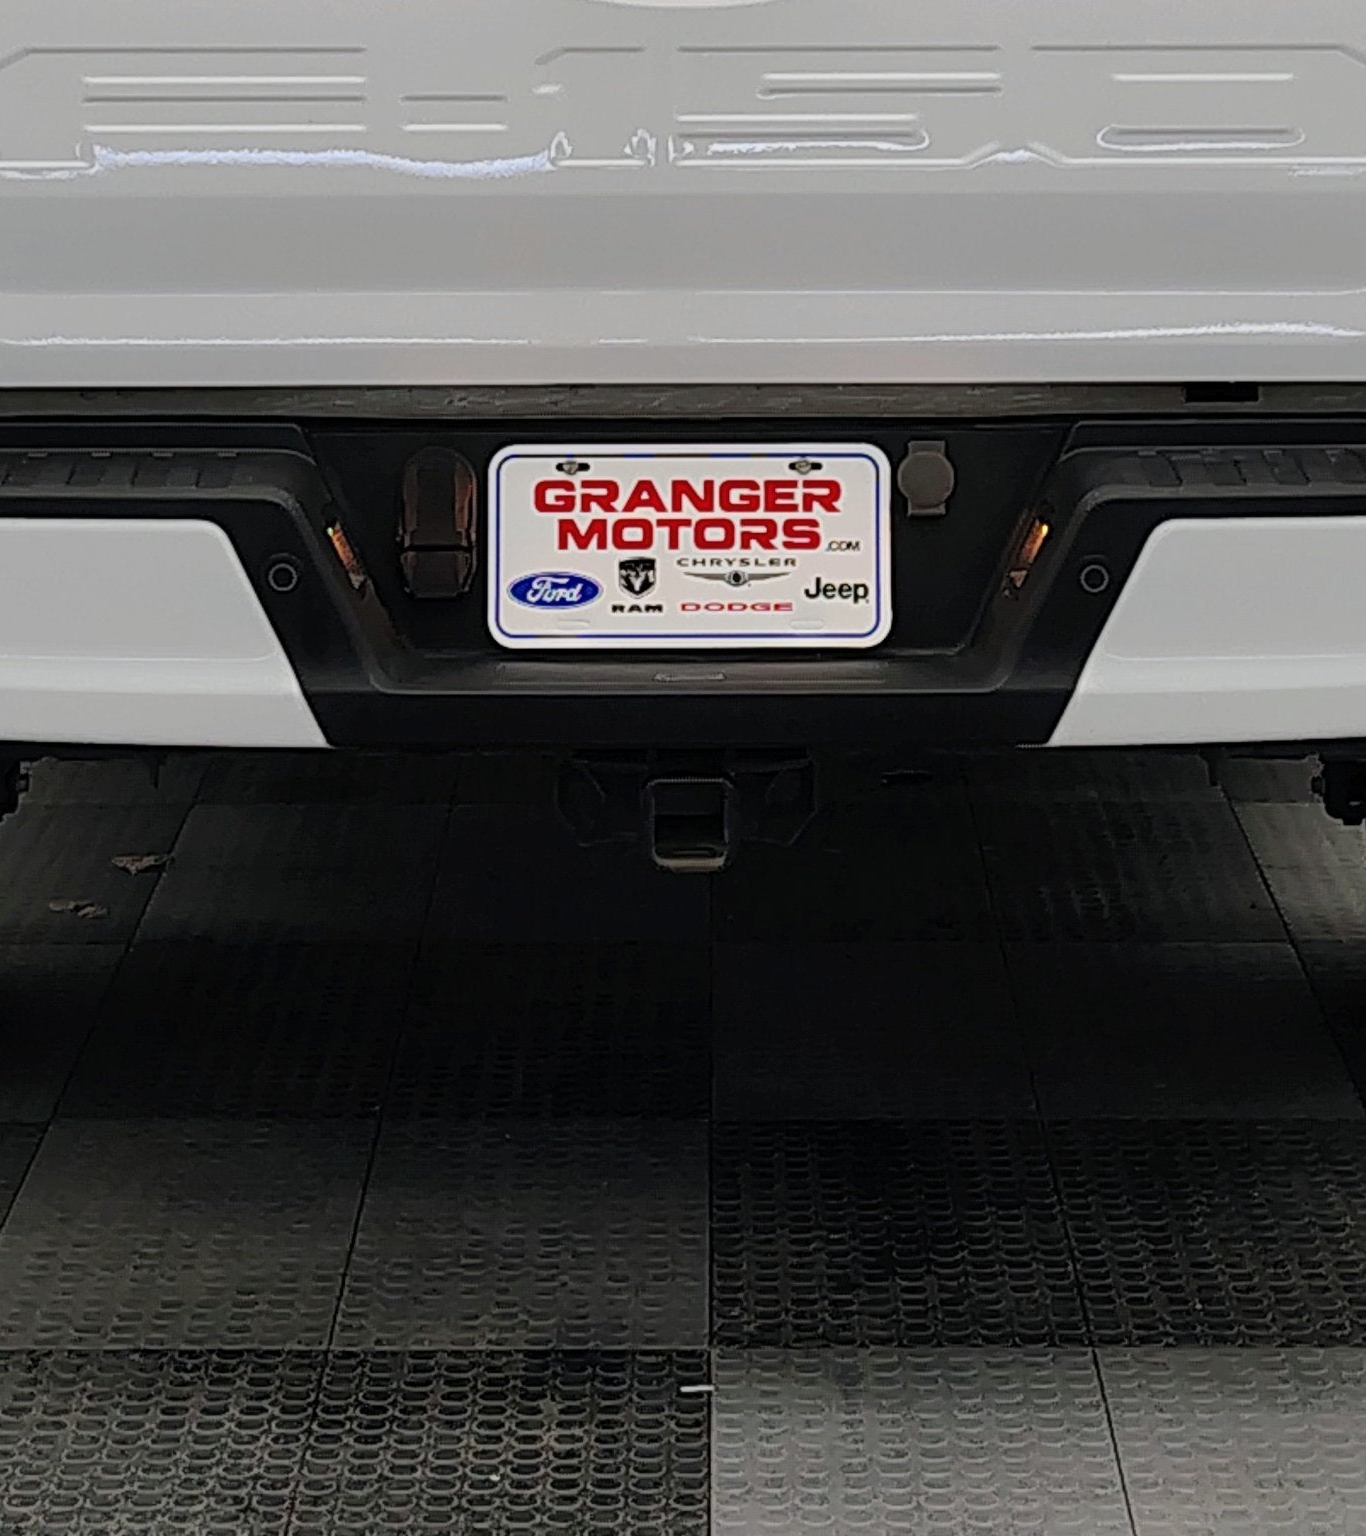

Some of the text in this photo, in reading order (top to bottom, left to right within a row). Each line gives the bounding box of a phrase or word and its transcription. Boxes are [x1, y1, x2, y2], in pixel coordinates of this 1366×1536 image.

[533, 479, 843, 513] GRANGER
[557, 518, 822, 551] MOTORS
[676, 557, 798, 568] CHRYSLER
[525, 578, 583, 604] Ford
[803, 577, 869, 604] Jeep
[611, 603, 664, 614] RAM
[680, 602, 794, 612] DODGE
